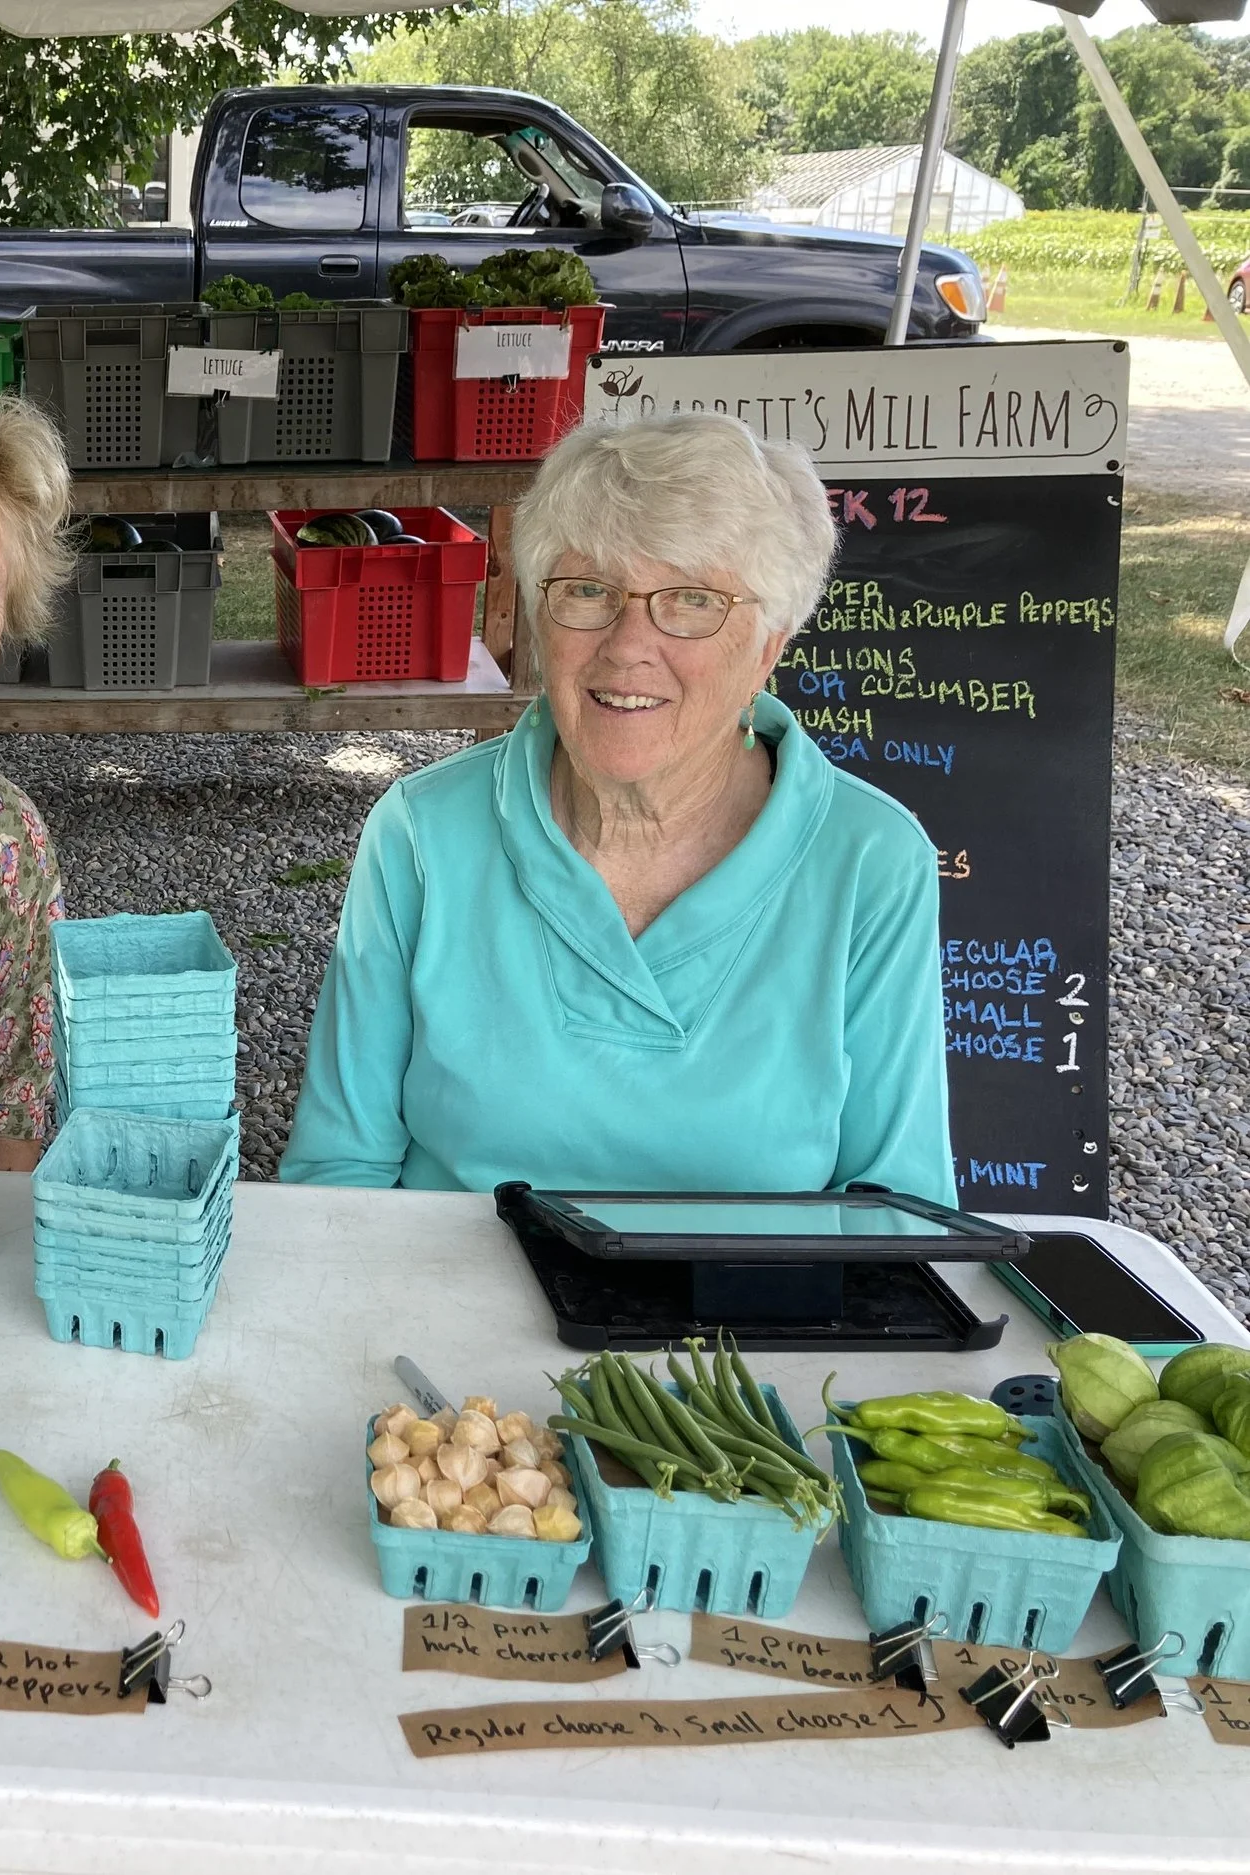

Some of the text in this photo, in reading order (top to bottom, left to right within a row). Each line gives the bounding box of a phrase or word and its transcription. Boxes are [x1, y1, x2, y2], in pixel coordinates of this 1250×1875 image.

[496, 331, 532, 347] LETTUCE
[599, 340, 664, 351] UNDRA
[202, 356, 243, 376] LETTUCE
[845, 386, 938, 451] MILL
[959, 384, 1070, 449] FARM
[825, 487, 950, 530] EK 12
[1019, 590, 1115, 633] PEPPERS
[777, 645, 917, 680] CALLIONS
[798, 671, 846, 701] OR
[861, 674, 1036, 719] CUCUMBER
[793, 706, 874, 741] UASH
[883, 740, 956, 775] ONLY
[941, 938, 1058, 973] EGULAR
[1055, 973, 1090, 1006] 2
[1056, 1031, 1080, 1073] 1
[422, 1611, 552, 1639] 1/2 pint
[721, 1625, 831, 1657] 1 pint
[25, 1650, 80, 1671] hot
[421, 1634, 590, 1663] husk cherrie
[720, 1648, 788, 1671] green
[954, 1647, 979, 1666] 1
[1200, 1683, 1232, 1705] 1
[422, 1717, 527, 1748] Regular
[544, 1713, 634, 1736] choose
[684, 1710, 764, 1735] Small
[776, 1708, 877, 1732] choose
[878, 1703, 918, 1730] 1
